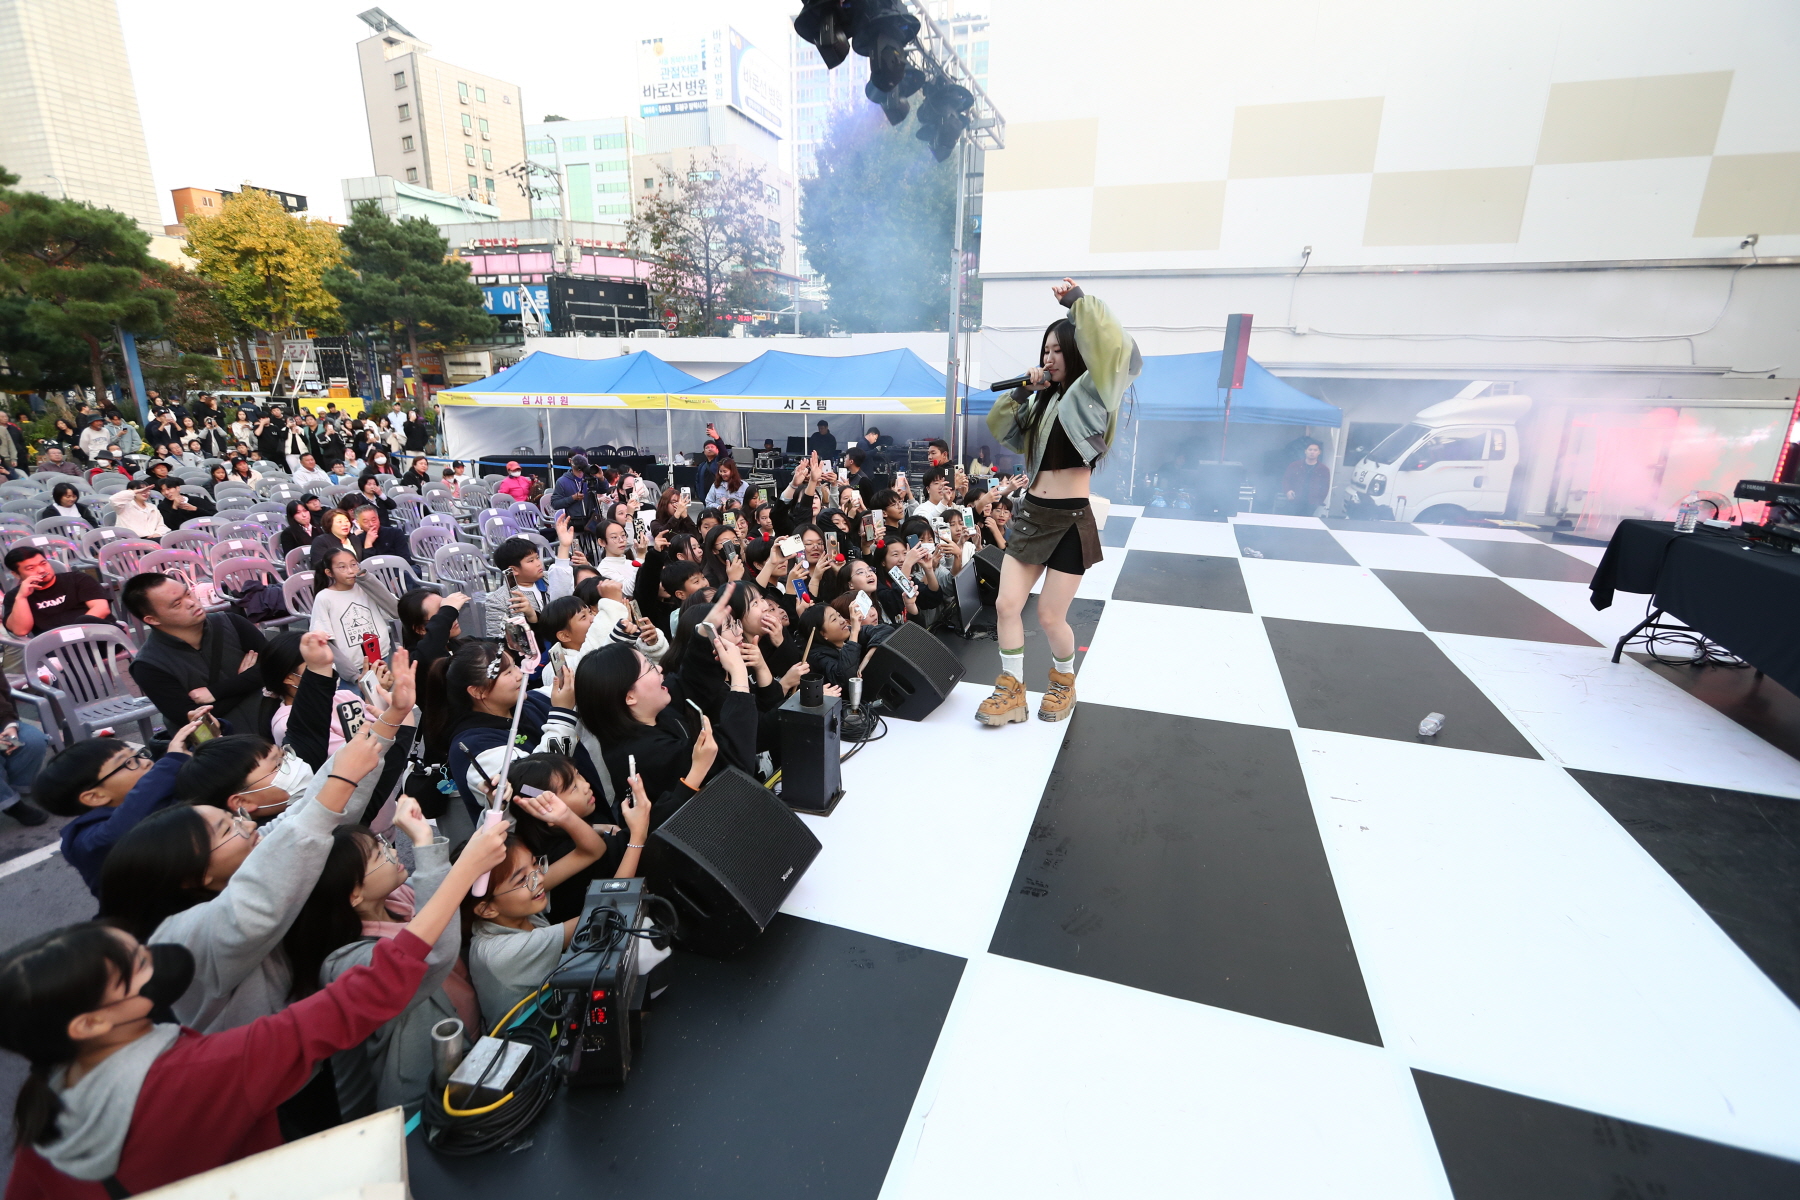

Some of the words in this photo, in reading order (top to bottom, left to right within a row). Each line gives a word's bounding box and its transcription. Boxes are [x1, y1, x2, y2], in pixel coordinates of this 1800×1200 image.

[712, 29, 722, 68] 바로선
[660, 64, 699, 80] 관절전문
[643, 80, 682, 99] 바로선
[685, 78, 708, 97] 병원
[714, 73, 723, 100] 병원
[521, 395, 569, 406] 심사위원
[784, 399, 828, 411] 시스템
[1746, 484, 1766, 492] YAMAHA
[349, 629, 376, 644] PAK
